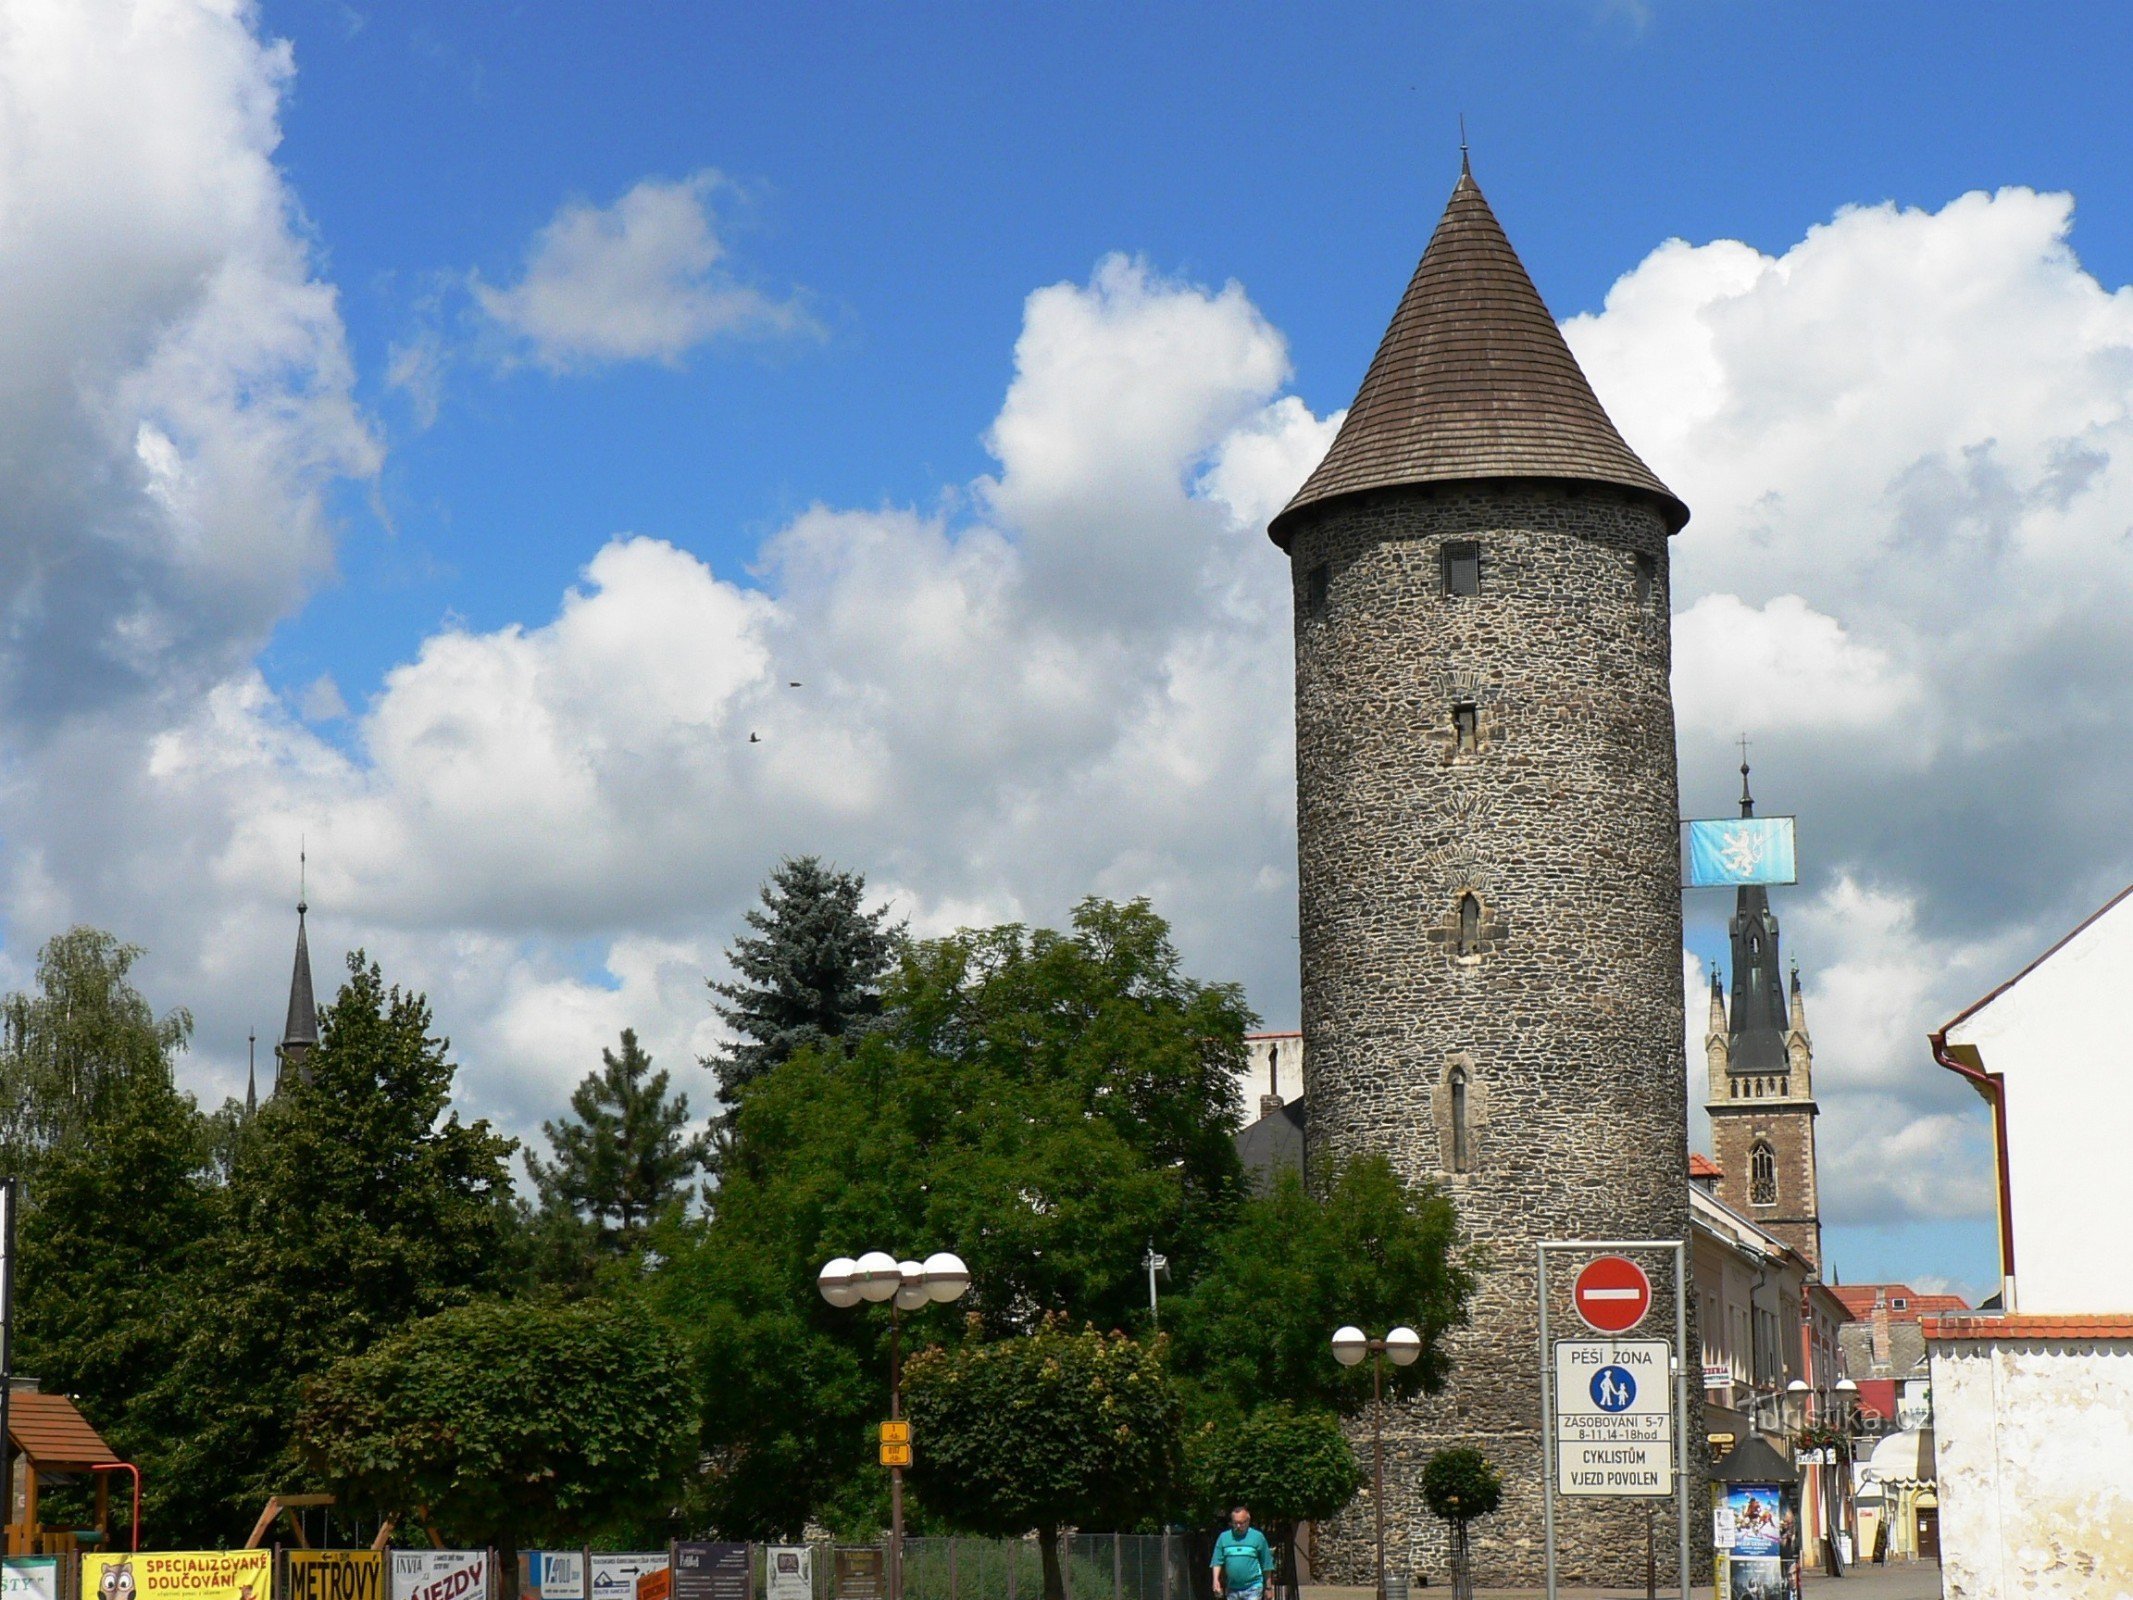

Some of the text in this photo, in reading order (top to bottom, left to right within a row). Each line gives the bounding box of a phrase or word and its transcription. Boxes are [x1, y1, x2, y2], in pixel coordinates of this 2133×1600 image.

[1571, 1348, 1652, 1364] PĚŠÍ ZÓNA
[1564, 1414, 1664, 1427] ZÁSOBOVÁNÍ 5-7
[1583, 1446, 1646, 1464] CYKLISTŮM
[1571, 1472, 1658, 1485] VJEZD POVOLEN
[147, 1553, 267, 1573] SPECIALIZOVANÉ
[148, 1571, 237, 1589] DOUČOVÁNÍ
[291, 1555, 380, 1600] METROVÝ
